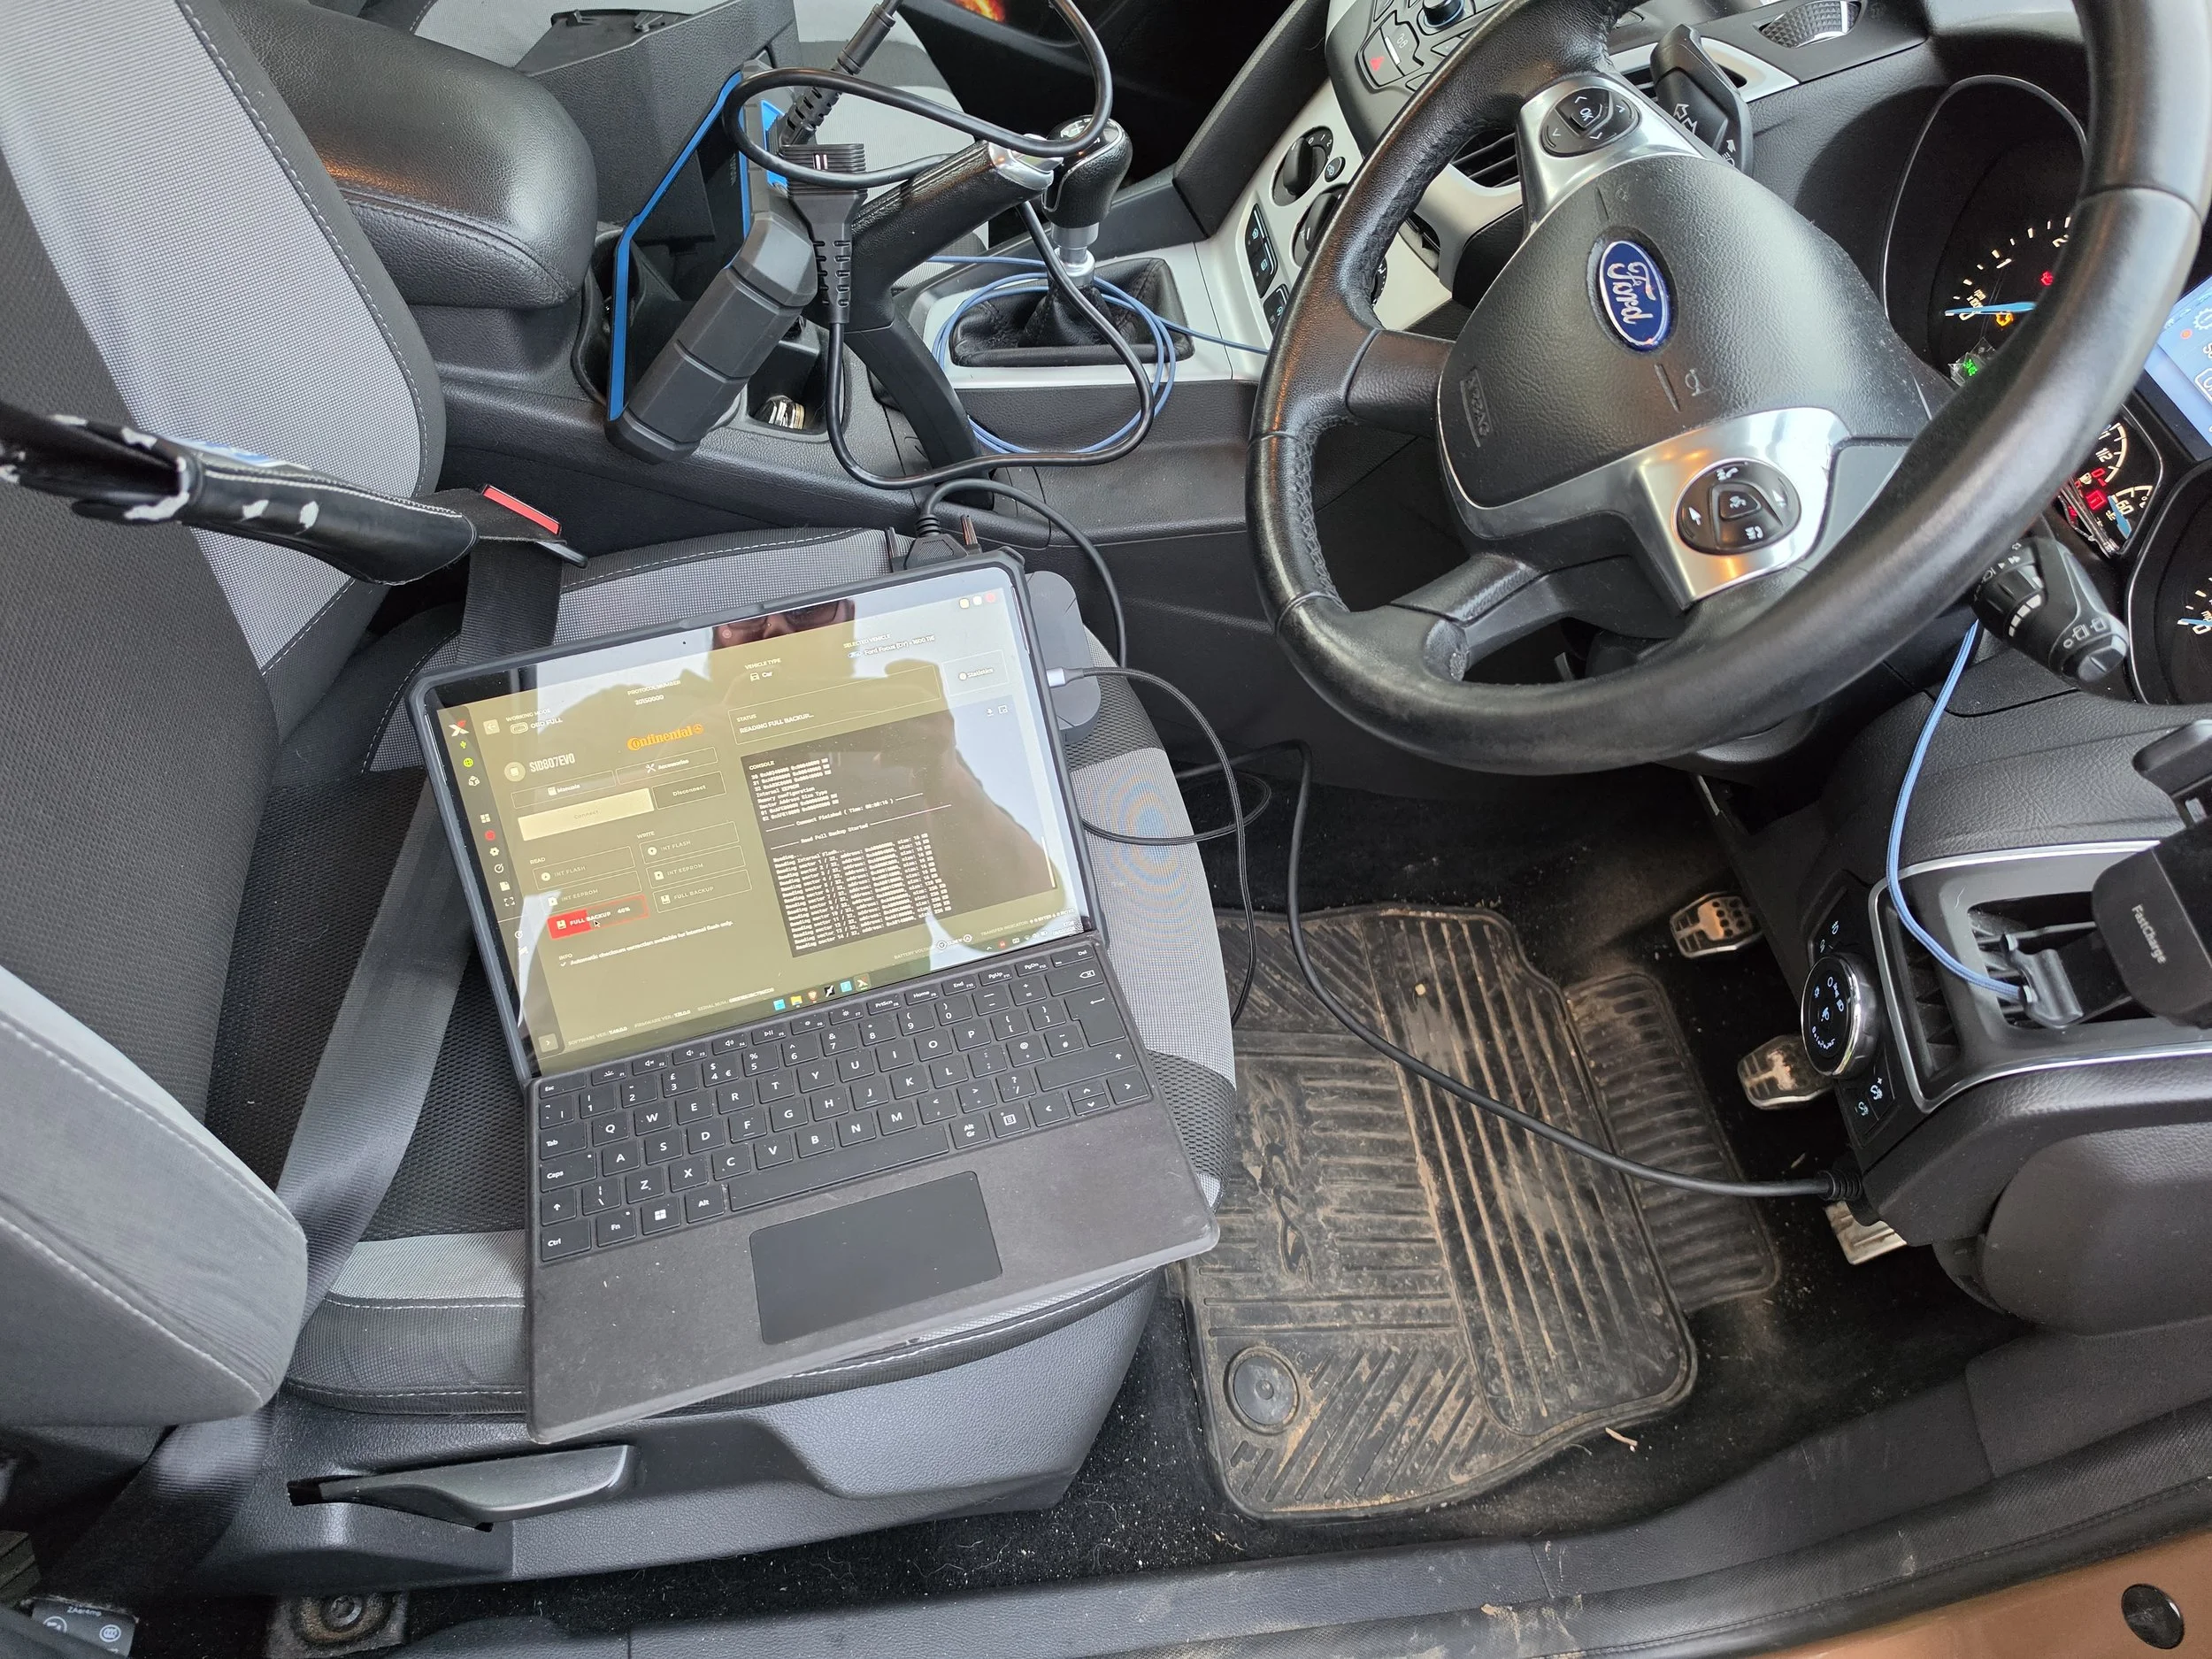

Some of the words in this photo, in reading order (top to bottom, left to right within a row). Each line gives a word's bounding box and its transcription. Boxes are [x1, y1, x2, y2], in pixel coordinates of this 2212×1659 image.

[1579, 107, 1594, 121] OK
[1607, 261, 1656, 325] Ford
[864, 647, 878, 656] Ford
[878, 643, 895, 652] Focus
[744, 660, 766, 669] VEHICLE
[966, 666, 994, 678] Statistics
[626, 686, 655, 695] PROTOCOL
[655, 680, 680, 689] NUMBER
[505, 711, 534, 722] WORKING
[544, 716, 563, 726] FULL
[736, 713, 757, 722] STATUS
[739, 722, 768, 733] READING
[768, 718, 783, 727] FULL
[626, 726, 694, 750] Continental
[528, 753, 575, 772] SID807EVO
[657, 758, 689, 770] Accessories
[749, 760, 774, 770] CONSOLE
[557, 783, 580, 793] Manuals
[672, 784, 706, 796] Disconnect
[756, 787, 780, 797] Internal
[757, 795, 776, 804] Memory
[777, 786, 815, 799] configuration
[779, 795, 800, 805] Address
[573, 809, 599, 819] Connect
[795, 816, 817, 826] Connect
[818, 810, 842, 820] Finished
[828, 828, 847, 837] Backup
[848, 823, 868, 833] Started
[672, 840, 690, 849] FLASH
[774, 859, 795, 869] Reading
[797, 853, 821, 864] Internal
[565, 865, 586, 874] FLASH
[678, 863, 703, 872] EEPROM
[776, 865, 797, 875] Reading
[798, 860, 817, 869] sector
[572, 888, 598, 898] EEPROM
[689, 886, 713, 895] BACKUP
[586, 910, 611, 921] BACKUP
[2131, 903, 2166, 964] FastCharge
[570, 954, 598, 965] Automatic
[598, 947, 625, 958] checksum
[626, 940, 653, 951] correction
[653, 933, 677, 944] available
[686, 926, 706, 936] internal
[1025, 962, 1039, 971] PgDn
[988, 971, 1002, 980] PgUp
[875, 999, 893, 1008] PrtScn
[867, 1088, 872, 1097] J
[647, 1112, 658, 1122] W
[784, 1110, 793, 1118] G
[891, 1112, 902, 1121] M
[605, 1124, 615, 1134] Q
[702, 1132, 710, 1141] D
[811, 1135, 818, 1144] B
[660, 1142, 666, 1151] S
[769, 1146, 777, 1156] V
[617, 1154, 625, 1163] A
[727, 1157, 734, 1166] C
[547, 1171, 564, 1179] Caps
[684, 1169, 693, 1178] X
[641, 1180, 648, 1189] Z
